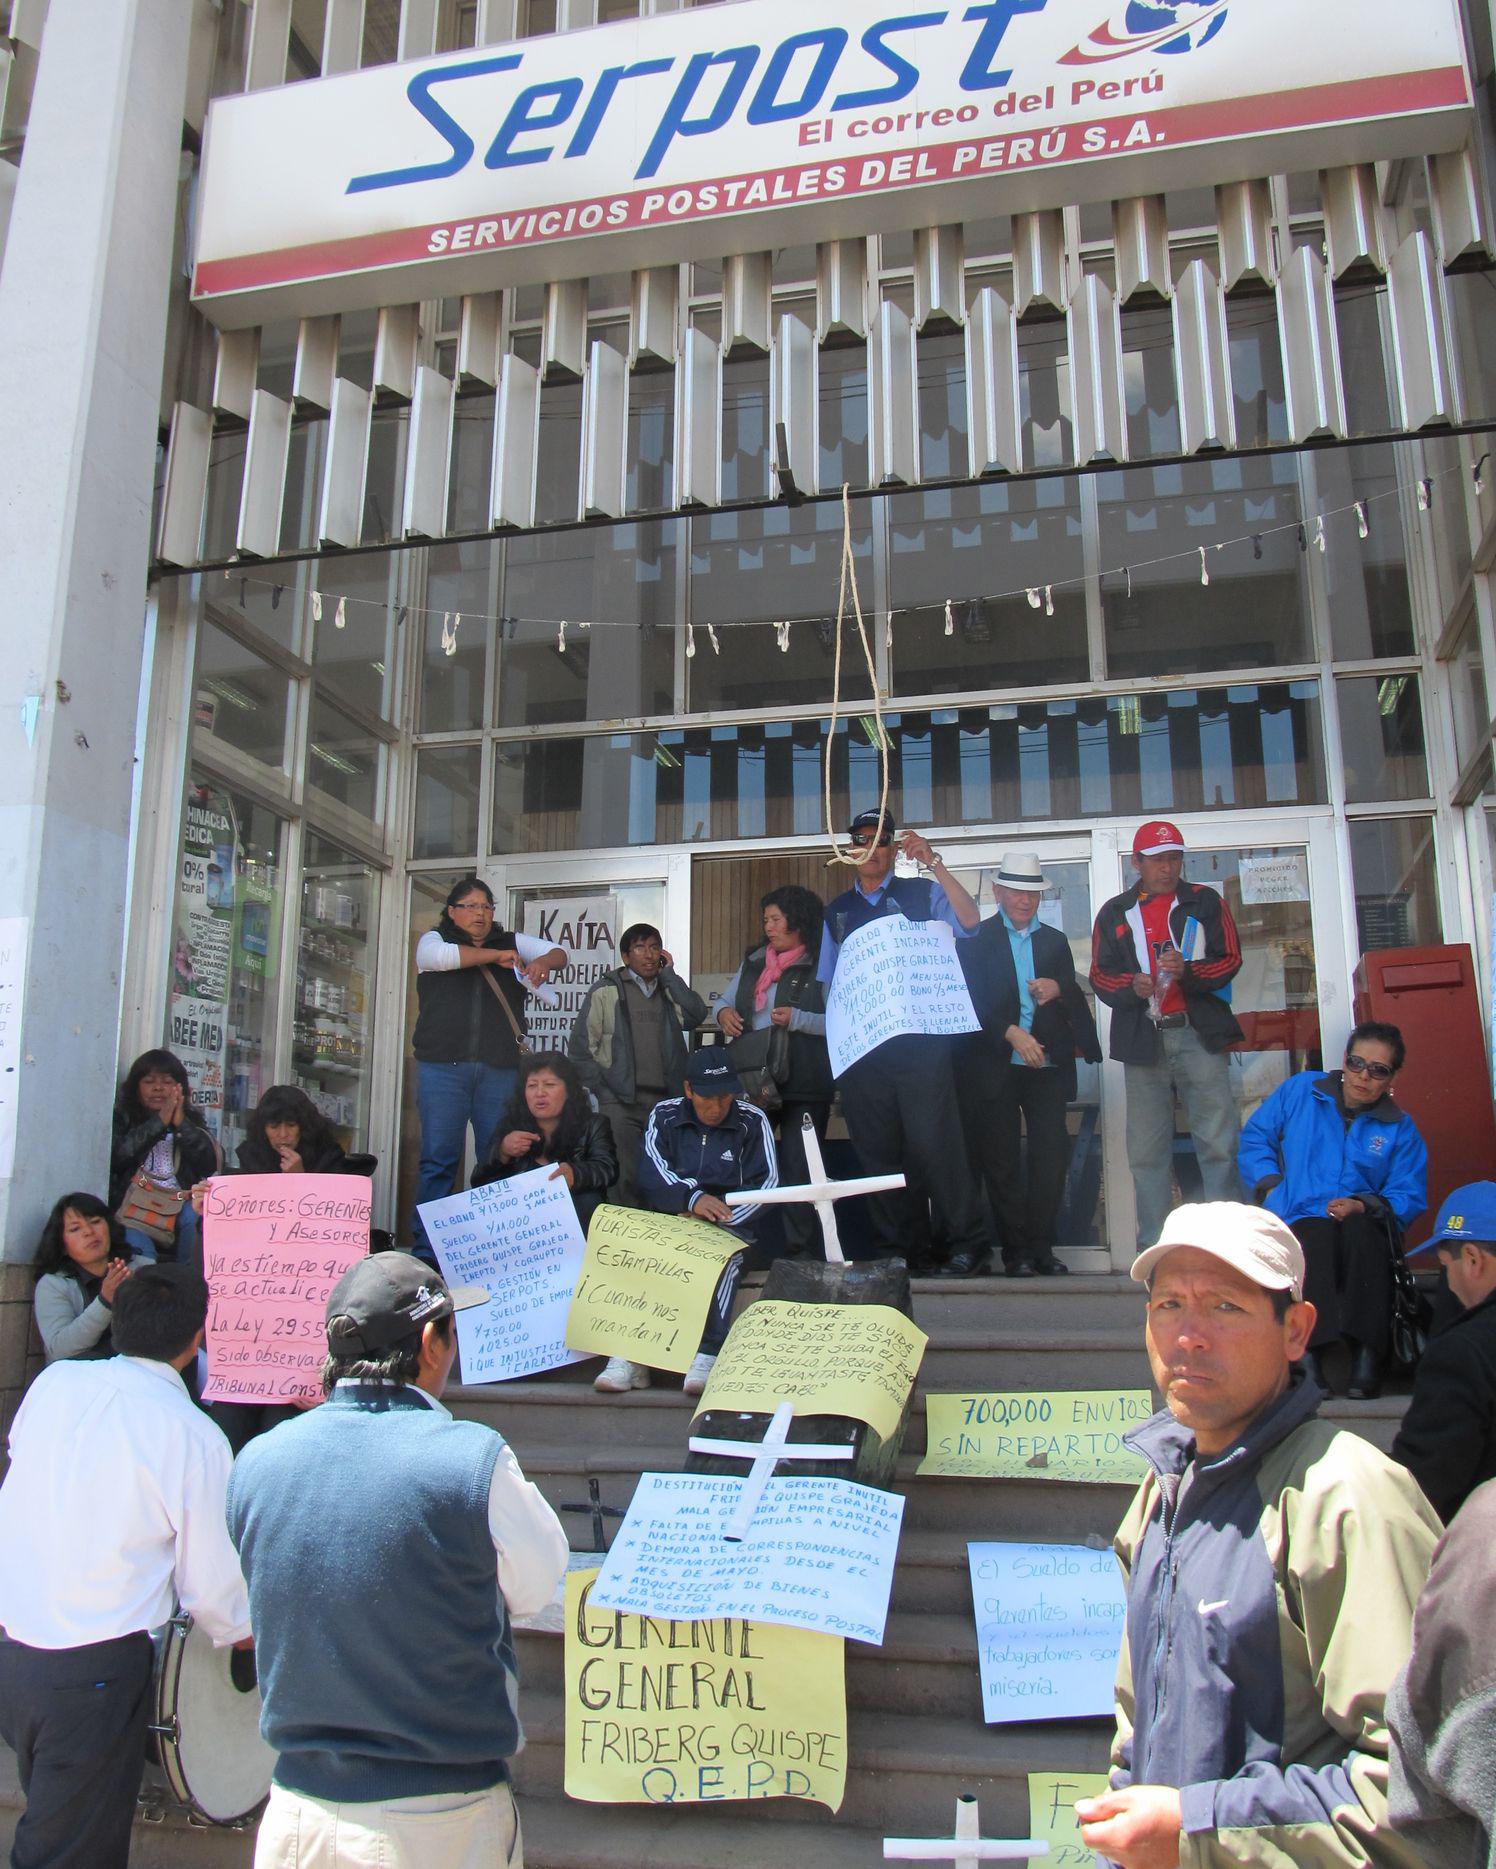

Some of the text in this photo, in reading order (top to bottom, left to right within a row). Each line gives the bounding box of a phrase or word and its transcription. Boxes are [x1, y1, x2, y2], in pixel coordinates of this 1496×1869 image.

[345, 0, 1048, 194] Serpost
[798, 67, 1165, 147] El correo del Perú
[428, 117, 1166, 254] SERVICIOS POSTALES DEL PERÚ S.A.
[468, 1236, 511, 1256] GERENTE
[514, 1219, 562, 1241] GENERAL
[233, 1308, 264, 1344] Ley
[961, 1397, 1052, 1428] 700,000
[936, 1432, 1120, 1457] SIN REPARTO
[785, 1480, 840, 1492] GERENTE
[649, 1519, 689, 1530] FALTA
[578, 1657, 766, 1712] GENERAL
[581, 1719, 841, 1772] FRIBERG QUISPE
